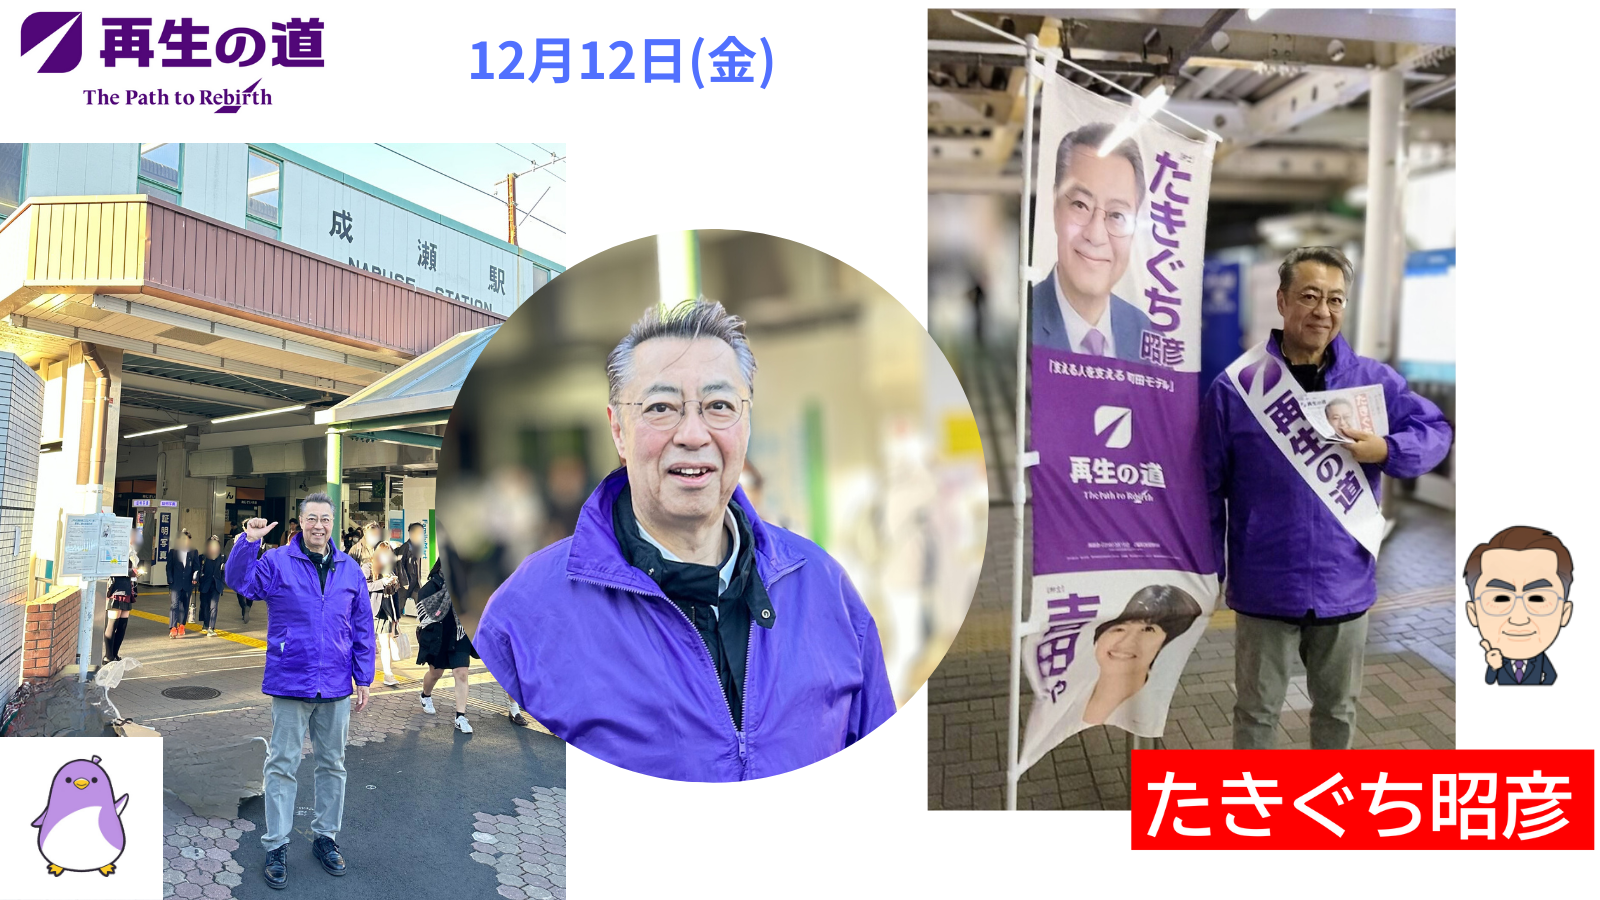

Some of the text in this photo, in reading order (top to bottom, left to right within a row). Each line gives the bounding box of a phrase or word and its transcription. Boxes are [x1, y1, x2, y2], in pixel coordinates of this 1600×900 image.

[1069, 456, 1166, 489] 再生の道
[1084, 491, 1099, 500] The
